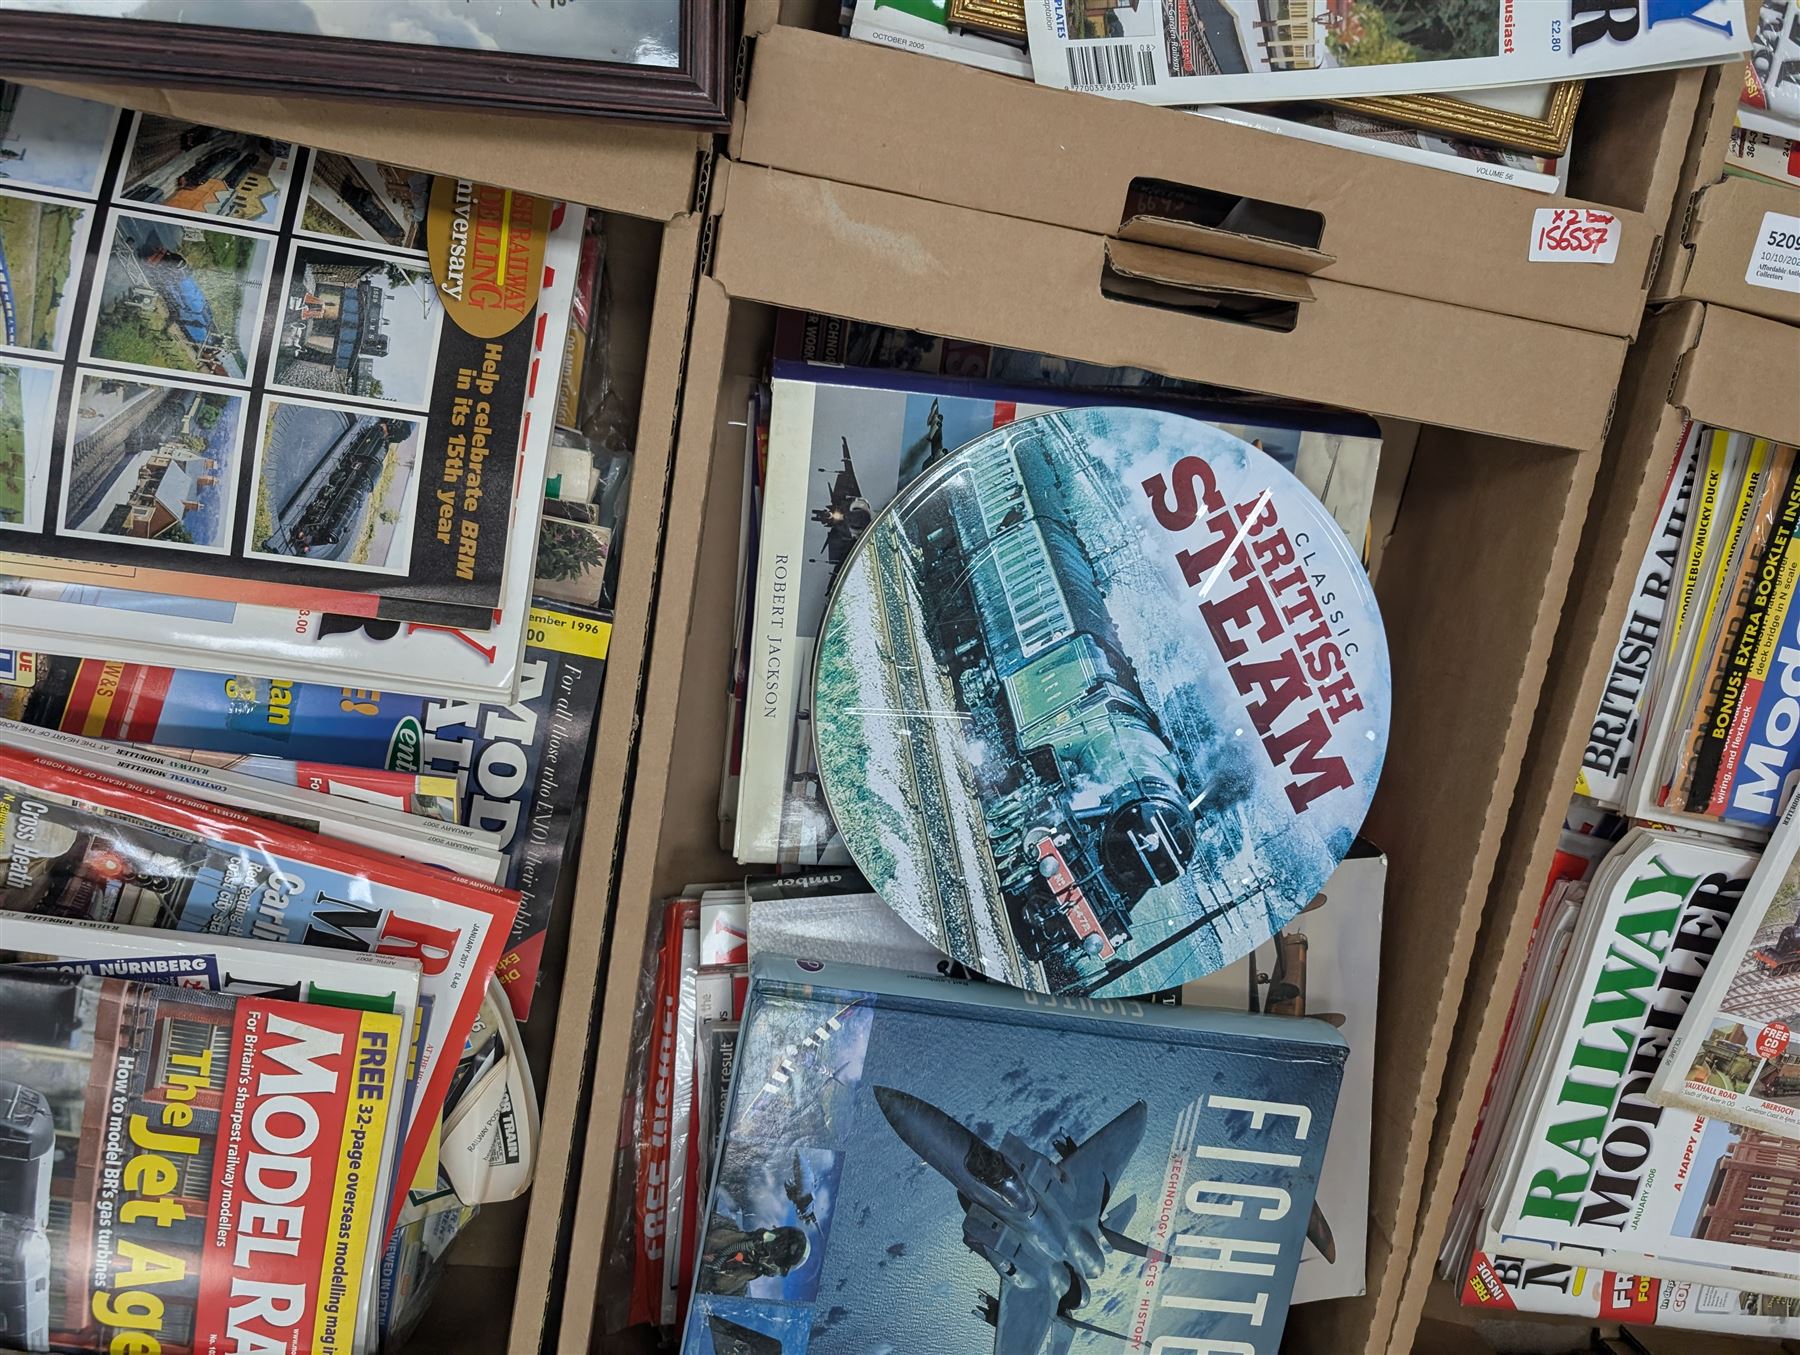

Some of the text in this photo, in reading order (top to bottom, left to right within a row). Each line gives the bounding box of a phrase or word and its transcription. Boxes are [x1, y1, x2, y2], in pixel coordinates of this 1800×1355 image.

[872, 32, 925, 50] OCTOBER 2005
[1551, 19, 1562, 52] £2.80
[1170, 41, 1181, 73] Railway
[1476, 164, 1504, 177] VOLUME
[504, 227, 534, 316] RAILWAY
[1756, 270, 1783, 281] Collectors
[436, 365, 477, 545] in its 15th year
[456, 343, 503, 580] Help celebrate BRM
[1737, 499, 1751, 523] TOY
[1746, 471, 1761, 499] FAIR
[1233, 489, 1365, 726] BRITISH
[1294, 532, 1359, 658] CLASSIC
[571, 615, 600, 636] 1996
[764, 553, 789, 720] ROBERT JACKSON
[1140, 455, 1356, 815] STEAM
[1712, 671, 1743, 740] BONUS:
[1735, 612, 1764, 667] EXTRA
[1754, 525, 1790, 607] BOOKLET
[1755, 653, 1769, 677] deck
[1764, 614, 1781, 654] bridge
[1775, 601, 1785, 613] in
[1784, 561, 1798, 590] scale
[560, 663, 583, 696] For
[1581, 610, 1662, 778] BRITISH
[556, 698, 574, 722] all
[20, 724, 209, 775] RAILWAY MODELLER AT THE HEART OF THE
[34, 756, 66, 771] HOBBY
[547, 724, 570, 771] those
[1716, 704, 1752, 805] wiring, and flextrack
[67, 764, 87, 776] THE
[97, 774, 126, 790] HEART
[117, 760, 228, 793] CONTINENTAL MODELLER
[126, 784, 143, 793] THE
[539, 766, 560, 797] who
[144, 788, 156, 796] AT
[166, 793, 210, 811] MODELLER
[212, 807, 249, 822] RAILWAY
[422, 820, 475, 837] JANUARY 2007
[528, 799, 556, 847] ENJOY
[8, 799, 49, 890] Cross Heath
[427, 835, 480, 852] JANUARY 2007
[212, 855, 242, 914] coast city
[452, 875, 503, 894] JANUARY 2017
[520, 849, 544, 890] their
[772, 874, 843, 888] amber
[230, 860, 265, 927] Recreating
[24, 912, 120, 931] RAILWAY MODELLER
[99, 958, 208, 977] NÜRNBERG
[449, 922, 480, 990] JANUARY 2017 £4.40
[1518, 854, 1702, 1228] RAILWAY
[1762, 1026, 1790, 1042] FREE
[1763, 1036, 1780, 1049] CD
[421, 1054, 431, 1069] THE
[720, 1040, 734, 1083] result
[162, 1049, 213, 1128] The
[1683, 1088, 1696, 1098] South
[1684, 1081, 1738, 1100] VAUXHALL ROAD
[1760, 1100, 1794, 1115] ABERSOCH
[216, 1010, 262, 1248] For Britain's sharpest railway modellers
[232, 1012, 345, 1270] MODEL
[466, 1126, 489, 1153] RAILWAY
[501, 1113, 520, 1158] TRAIN
[94, 1055, 135, 1287] How to model BR's gas turbines
[1673, 1136, 1698, 1192] A HAPPY
[320, 1031, 389, 1343] FREE 32-page overseas modelling mag
[1629, 1167, 1657, 1231] JANUARY 2006
[92, 1113, 201, 1355] Jet Age
[1131, 1157, 1183, 1351] TECHNOLOGY HISTORY
[380, 1285, 392, 1298] IN
[1468, 1275, 1490, 1303] FREE
[1477, 1260, 1506, 1301] INSIDE
[1660, 1298, 1671, 1310] In
